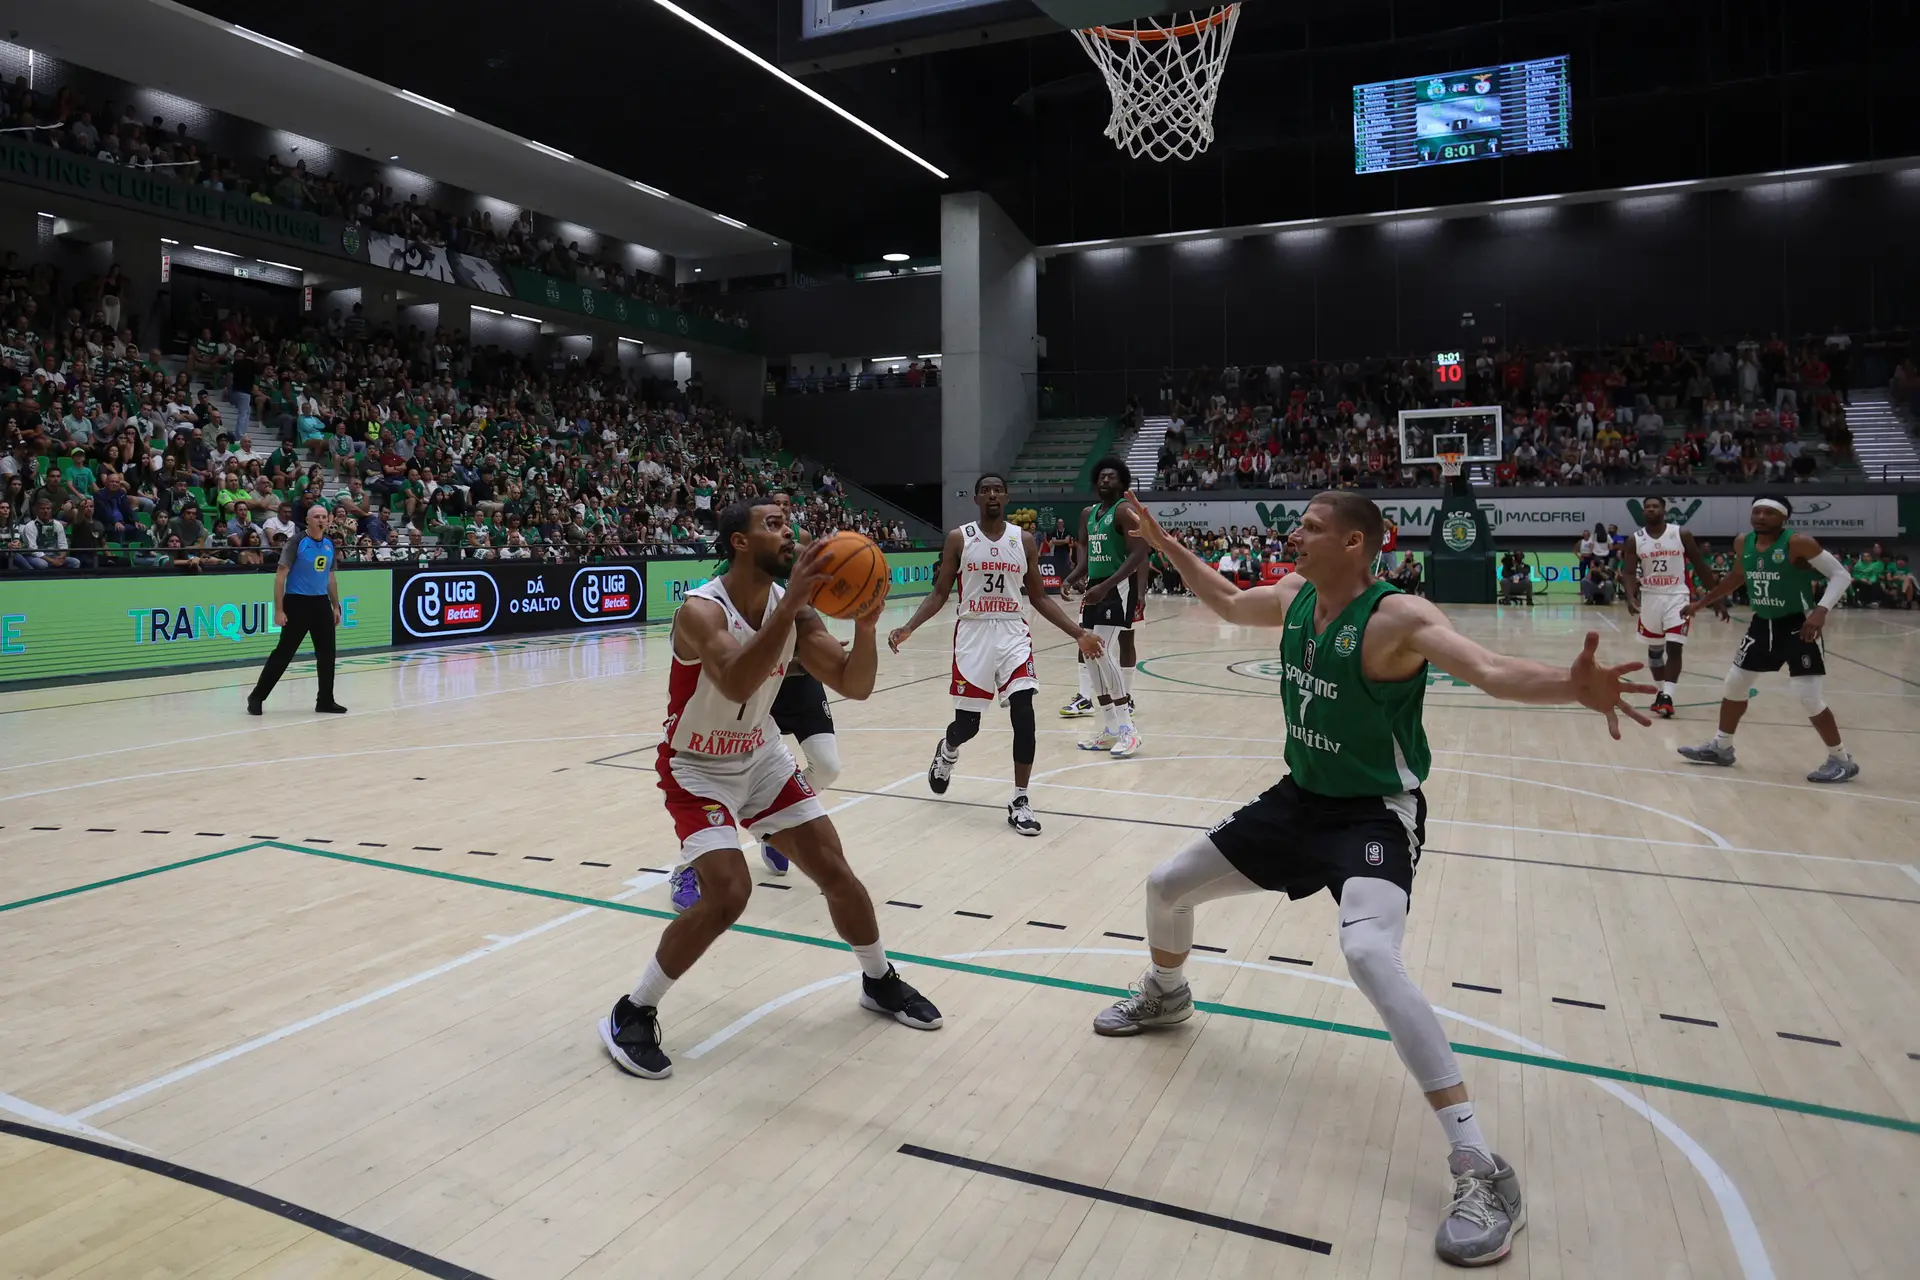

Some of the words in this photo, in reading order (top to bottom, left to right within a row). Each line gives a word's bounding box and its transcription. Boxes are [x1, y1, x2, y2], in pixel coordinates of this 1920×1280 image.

[1457, 120, 1462, 129] 1
[1444, 143, 1475, 158] 8:01
[98, 168, 181, 211] CLUBE
[185, 185, 217, 217] DE
[221, 195, 327, 245] PORTUGAL
[1437, 352, 1460, 362] 8:01
[1436, 365, 1462, 382] 10
[1506, 511, 1585, 522] MACOFREI
[1091, 541, 1102, 554] 30
[967, 562, 979, 572] SL
[981, 560, 1021, 574] BENFICA
[1652, 560, 1667, 572] 23
[1746, 571, 1780, 580] SPORTING
[526, 575, 544, 594] DÁ
[983, 573, 1005, 594] 34
[1753, 580, 1770, 597] 57
[509, 599, 519, 614] O
[521, 597, 560, 613] SALTO
[604, 596, 628, 609] Betclic
[968, 600, 1019, 613] RAMIREZ
[447, 606, 479, 621] Betclic
[1286, 662, 1338, 700] SPORTING
[1299, 688, 1313, 725] 7
